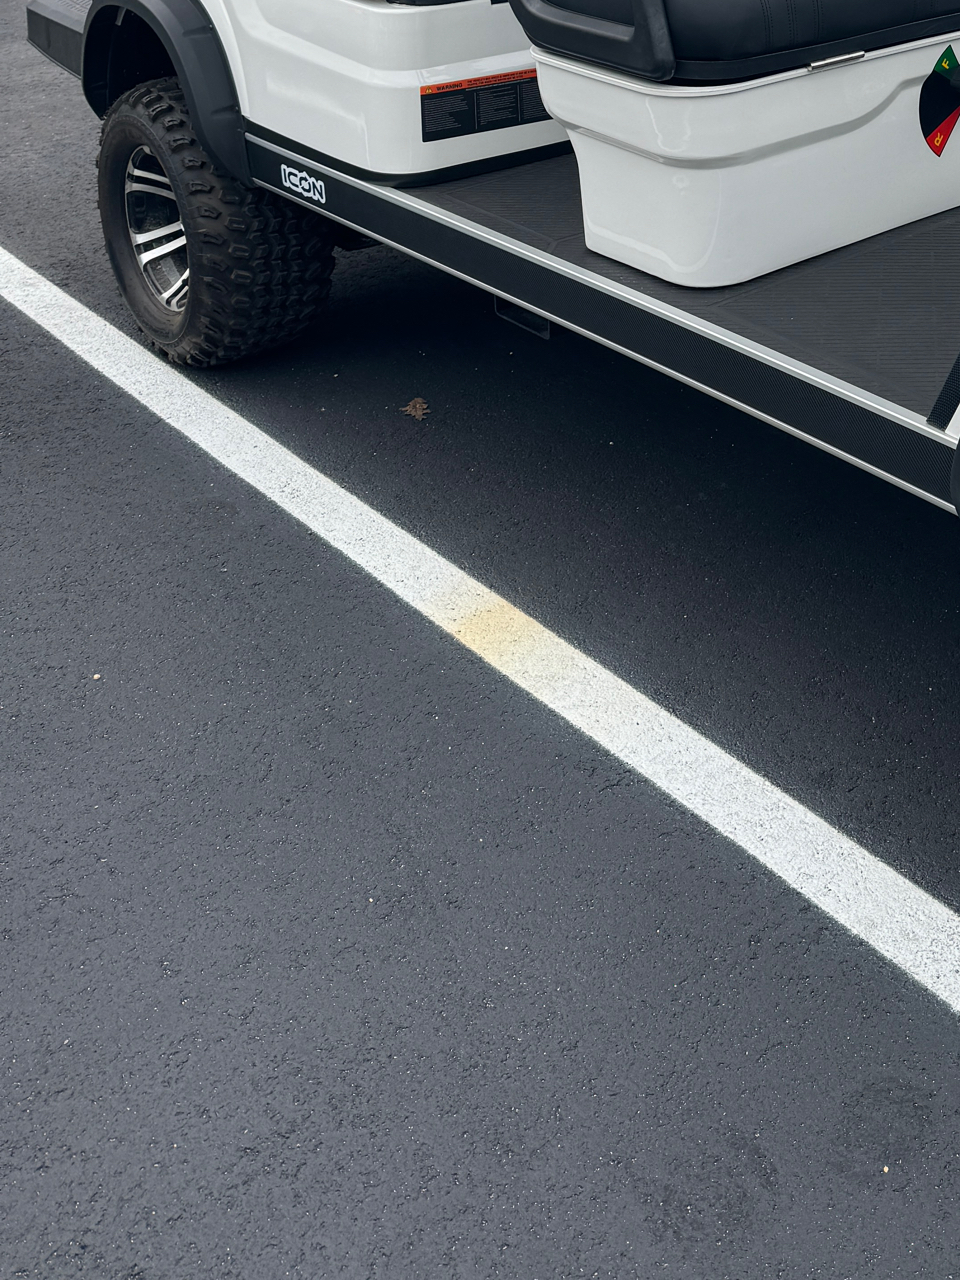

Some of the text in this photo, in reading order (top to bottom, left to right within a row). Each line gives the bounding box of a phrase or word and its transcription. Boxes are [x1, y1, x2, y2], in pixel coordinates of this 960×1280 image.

[941, 58, 949, 70] F
[436, 83, 463, 91] WARNING
[934, 132, 943, 146] R
[281, 164, 325, 204] ICON
